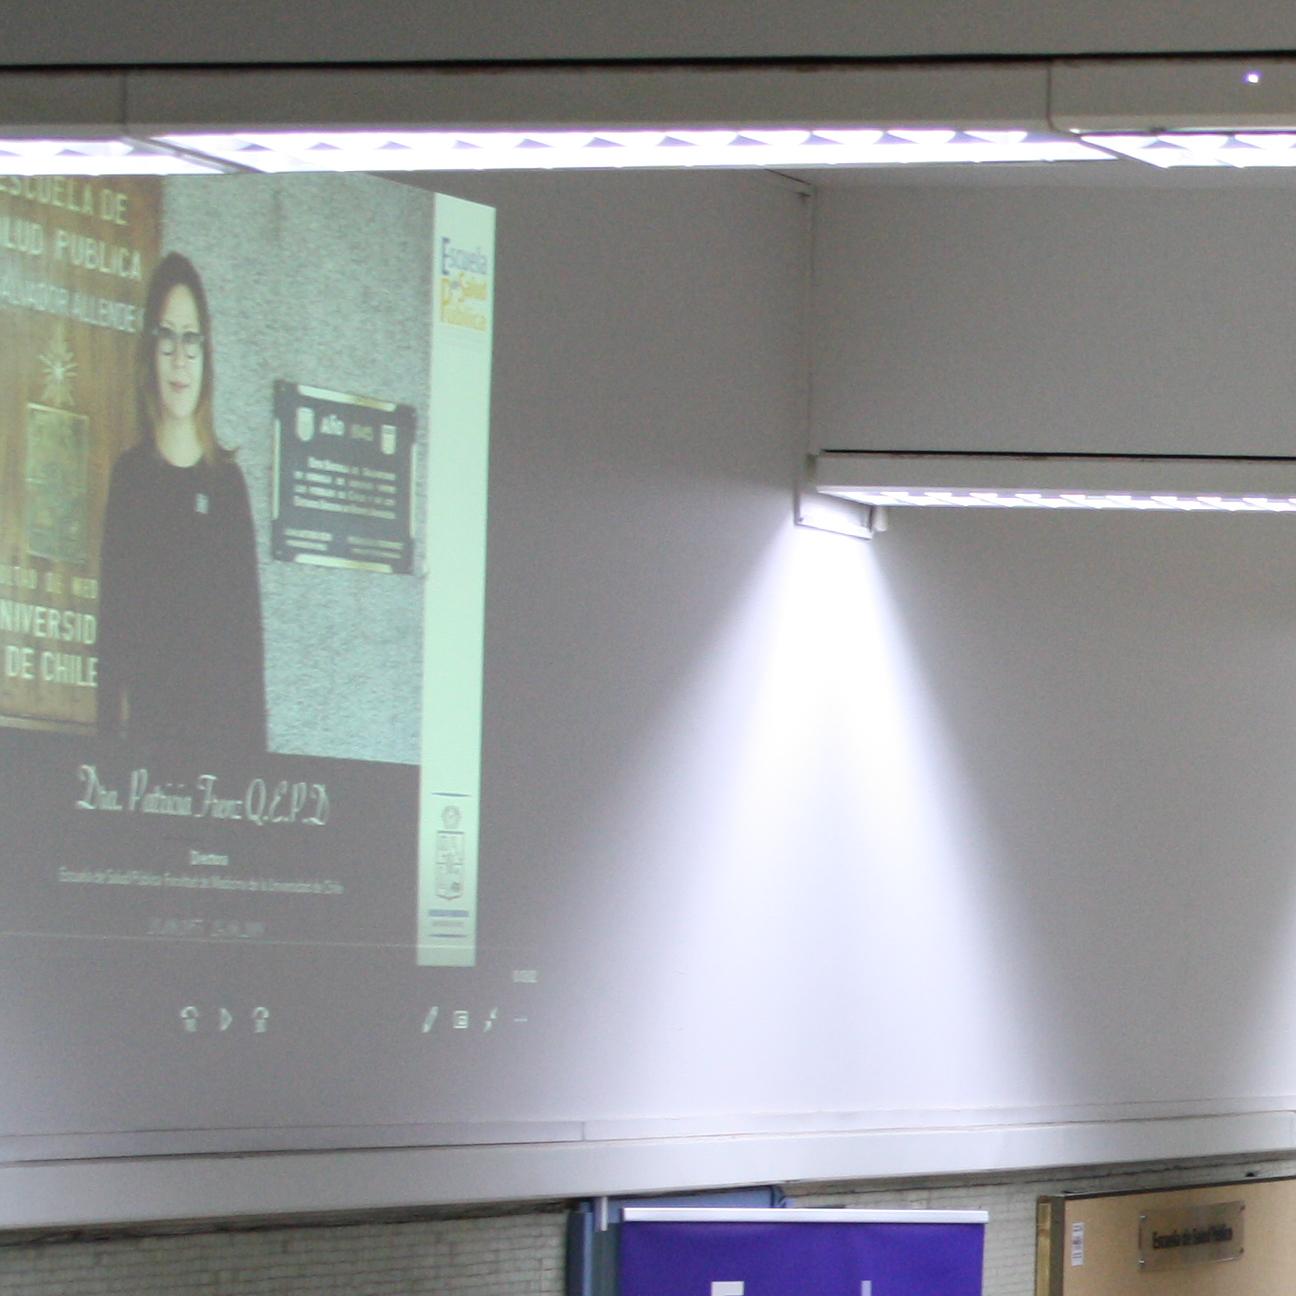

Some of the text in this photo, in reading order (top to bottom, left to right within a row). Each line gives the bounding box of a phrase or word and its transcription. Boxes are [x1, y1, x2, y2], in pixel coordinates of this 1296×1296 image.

[101, 189, 128, 225] DE
[5, 645, 98, 687] DE CHILE
